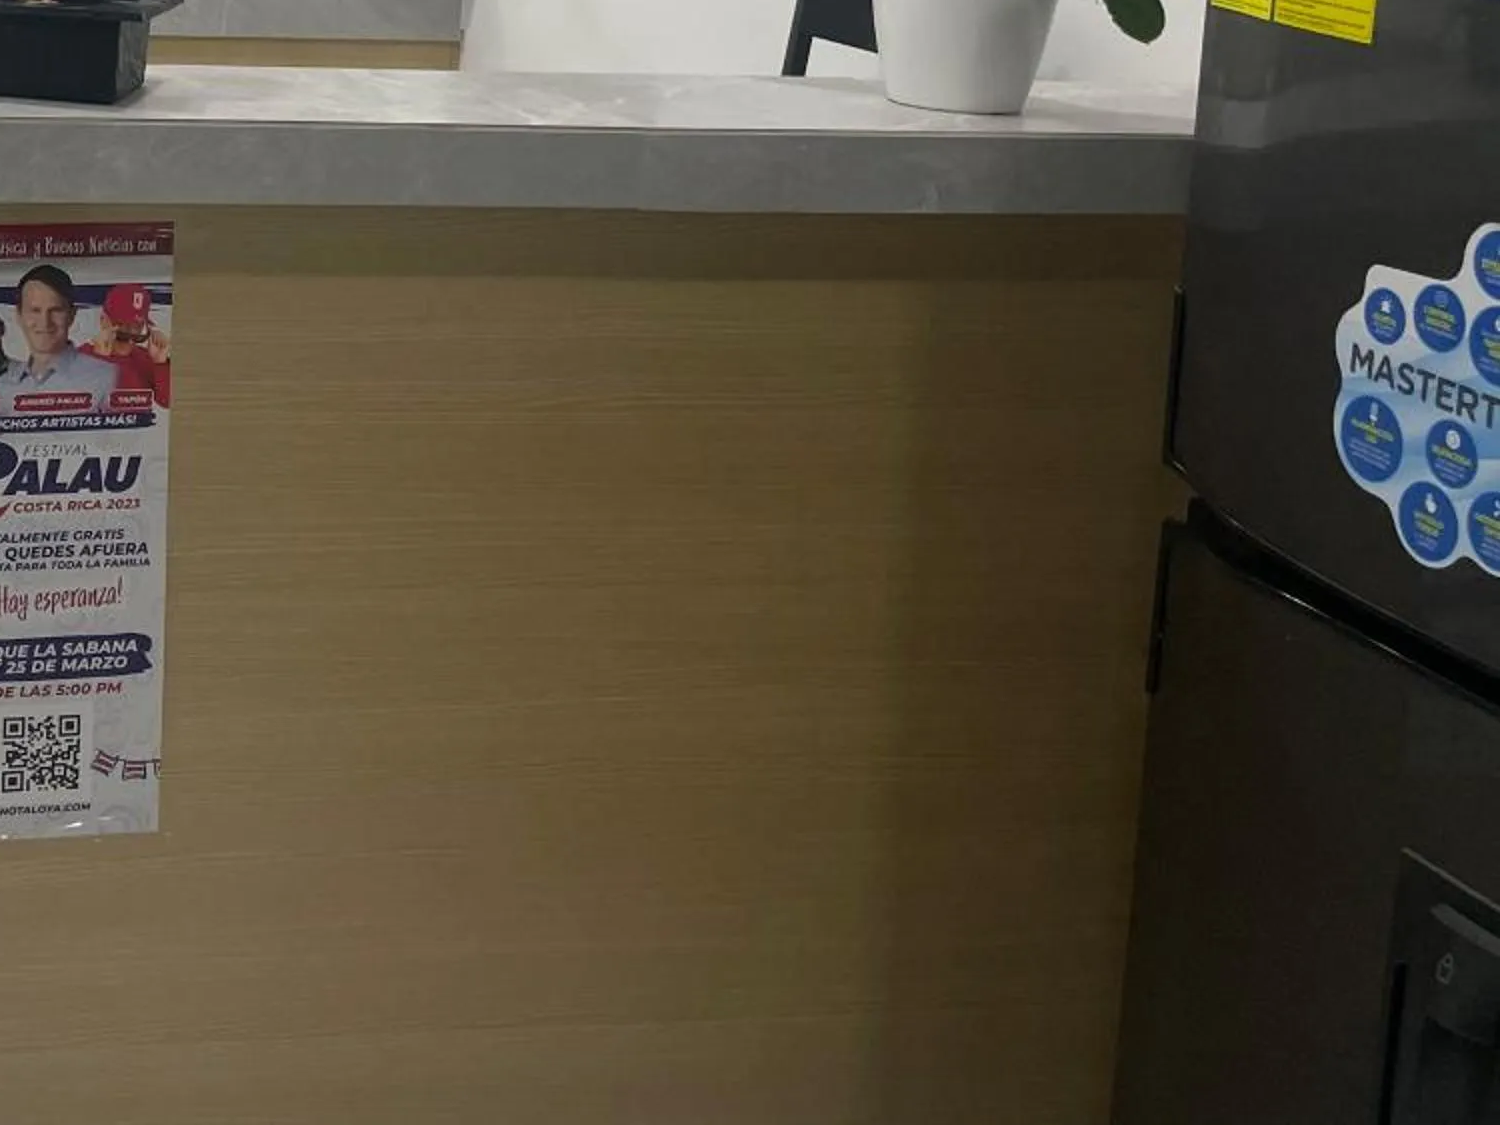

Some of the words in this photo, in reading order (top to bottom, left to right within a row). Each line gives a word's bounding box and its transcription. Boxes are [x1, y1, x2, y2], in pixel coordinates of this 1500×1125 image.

[33, 242, 41, 259] y
[137, 240, 157, 252] con
[40, 415, 101, 428] ARTISTAS
[23, 444, 88, 457] FESTIVAL
[13, 501, 63, 514] COSTA
[67, 500, 103, 511] RICA
[107, 498, 141, 510] 2023
[73, 529, 125, 541] GRATIS
[5, 544, 75, 562] QUEDES
[79, 542, 149, 557] AFUERA
[16, 562, 47, 571] PARA
[52, 560, 83, 570] TODA
[86, 559, 101, 568] LA
[104, 557, 150, 568] FAMILIA
[35, 575, 124, 616] esperanza!
[33, 643, 58, 657] LA
[61, 639, 139, 656] SABANA
[5, 660, 27, 674] 25
[31, 659, 57, 673] DE
[61, 656, 129, 672] MARZO
[19, 685, 53, 698] LAS
[56, 682, 91, 696] 5:00
[96, 681, 122, 694] PM
